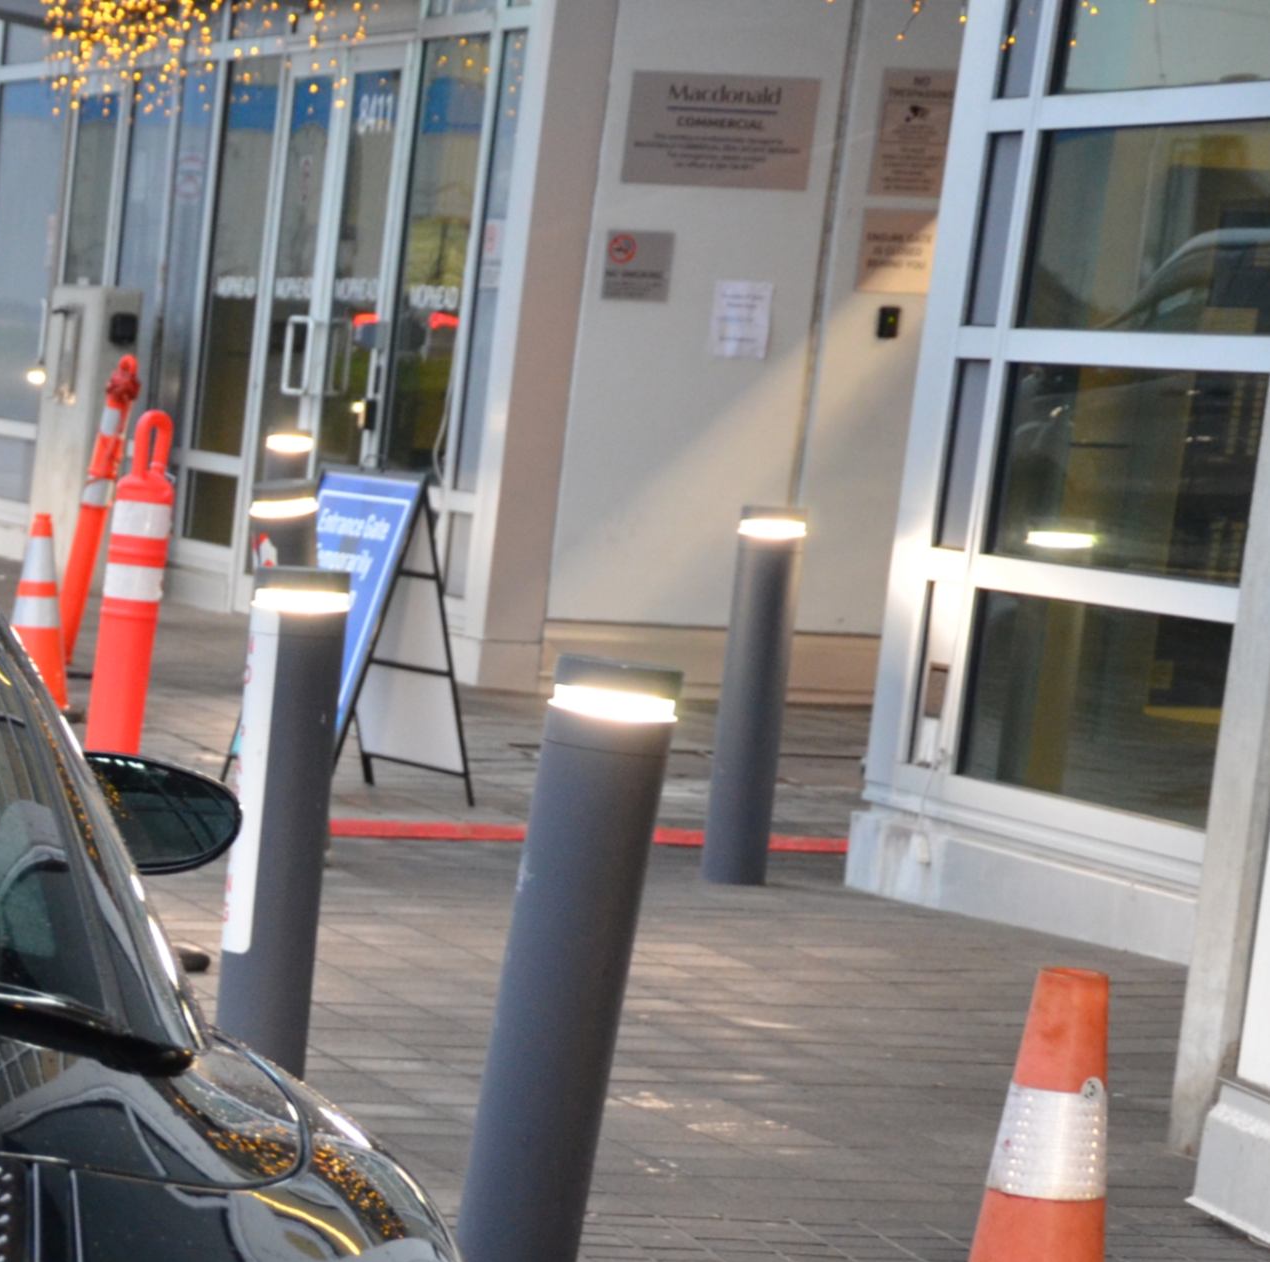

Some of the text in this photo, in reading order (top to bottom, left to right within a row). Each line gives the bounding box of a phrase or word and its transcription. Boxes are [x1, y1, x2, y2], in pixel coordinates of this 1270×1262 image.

[668, 83, 782, 105] Macdonald
[677, 116, 764, 131] COMMERCIAL
[317, 508, 391, 541] Entrance Gate
